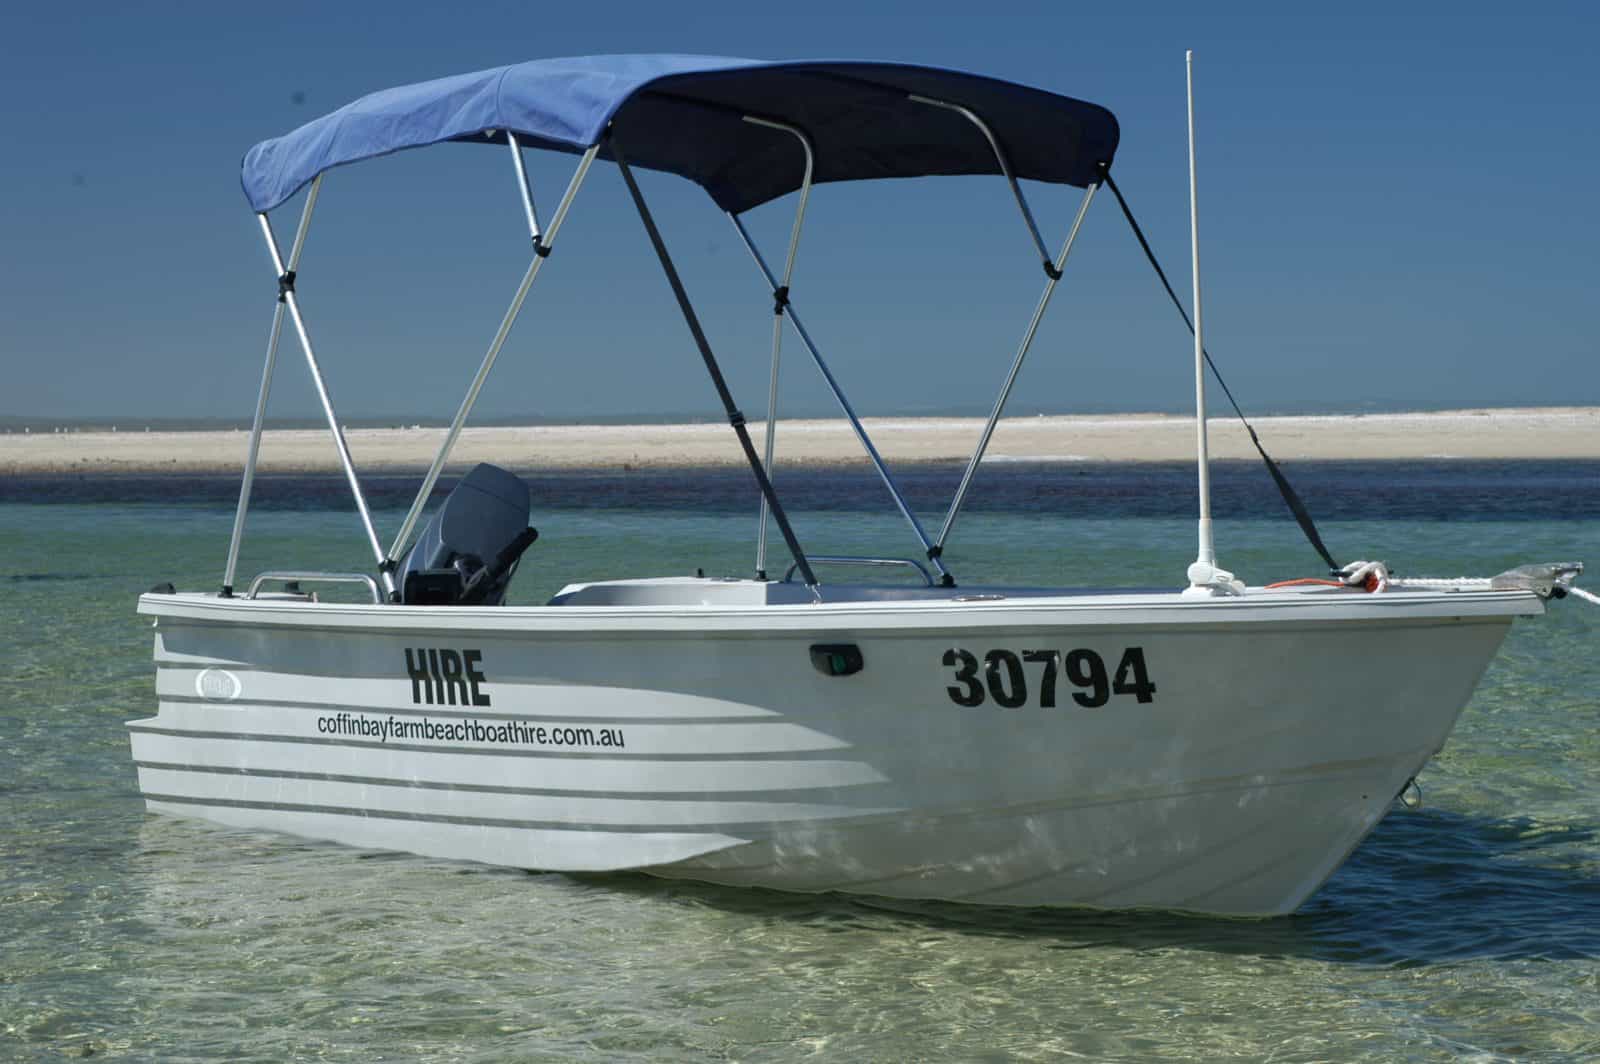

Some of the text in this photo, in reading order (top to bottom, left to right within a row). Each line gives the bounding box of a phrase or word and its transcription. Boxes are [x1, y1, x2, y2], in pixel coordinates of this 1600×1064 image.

[405, 647, 491, 707] HIRE
[942, 647, 1156, 708] 30794
[317, 713, 625, 748] coffinbayfarmbeachboathire.com.au
